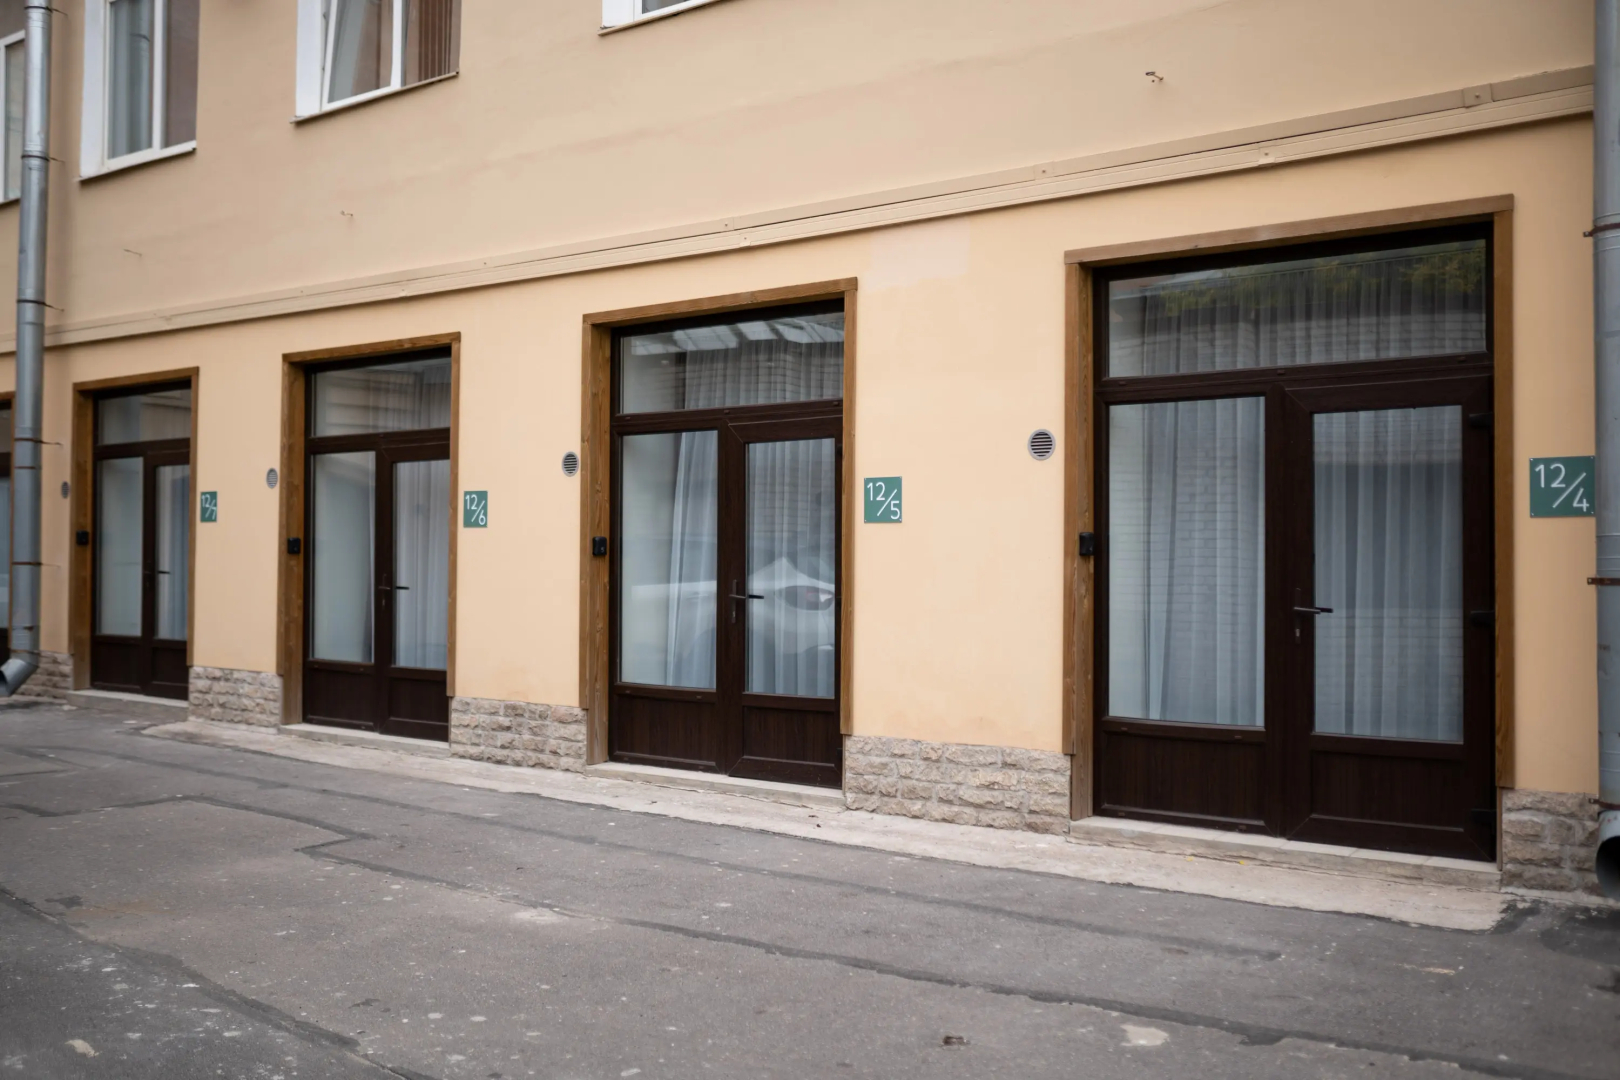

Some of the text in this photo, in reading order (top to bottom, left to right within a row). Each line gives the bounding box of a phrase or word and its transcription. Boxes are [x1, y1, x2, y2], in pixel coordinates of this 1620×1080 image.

[867, 481, 900, 520] 12/5
[1535, 463, 1590, 512] 12/4
[465, 494, 486, 525] 12/6
